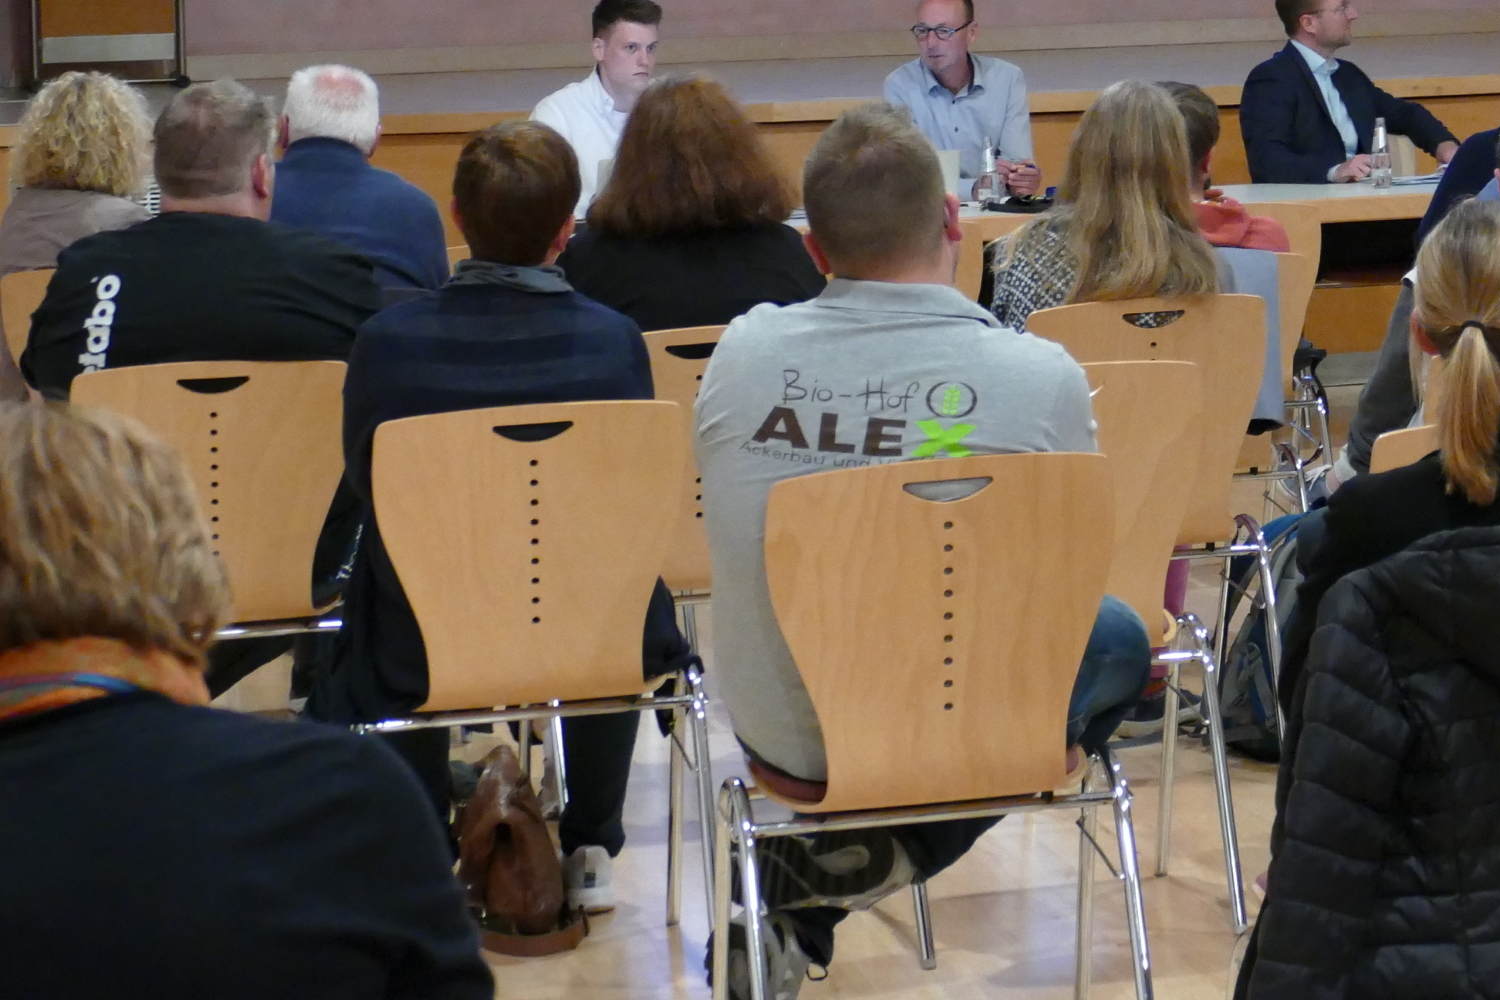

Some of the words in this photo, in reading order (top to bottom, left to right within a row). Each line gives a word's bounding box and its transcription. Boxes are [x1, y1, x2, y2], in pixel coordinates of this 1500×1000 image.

[782, 369, 920, 413] Bio-Hof
[739, 440, 825, 465] Ackerbau
[752, 406, 977, 458] ALEX
